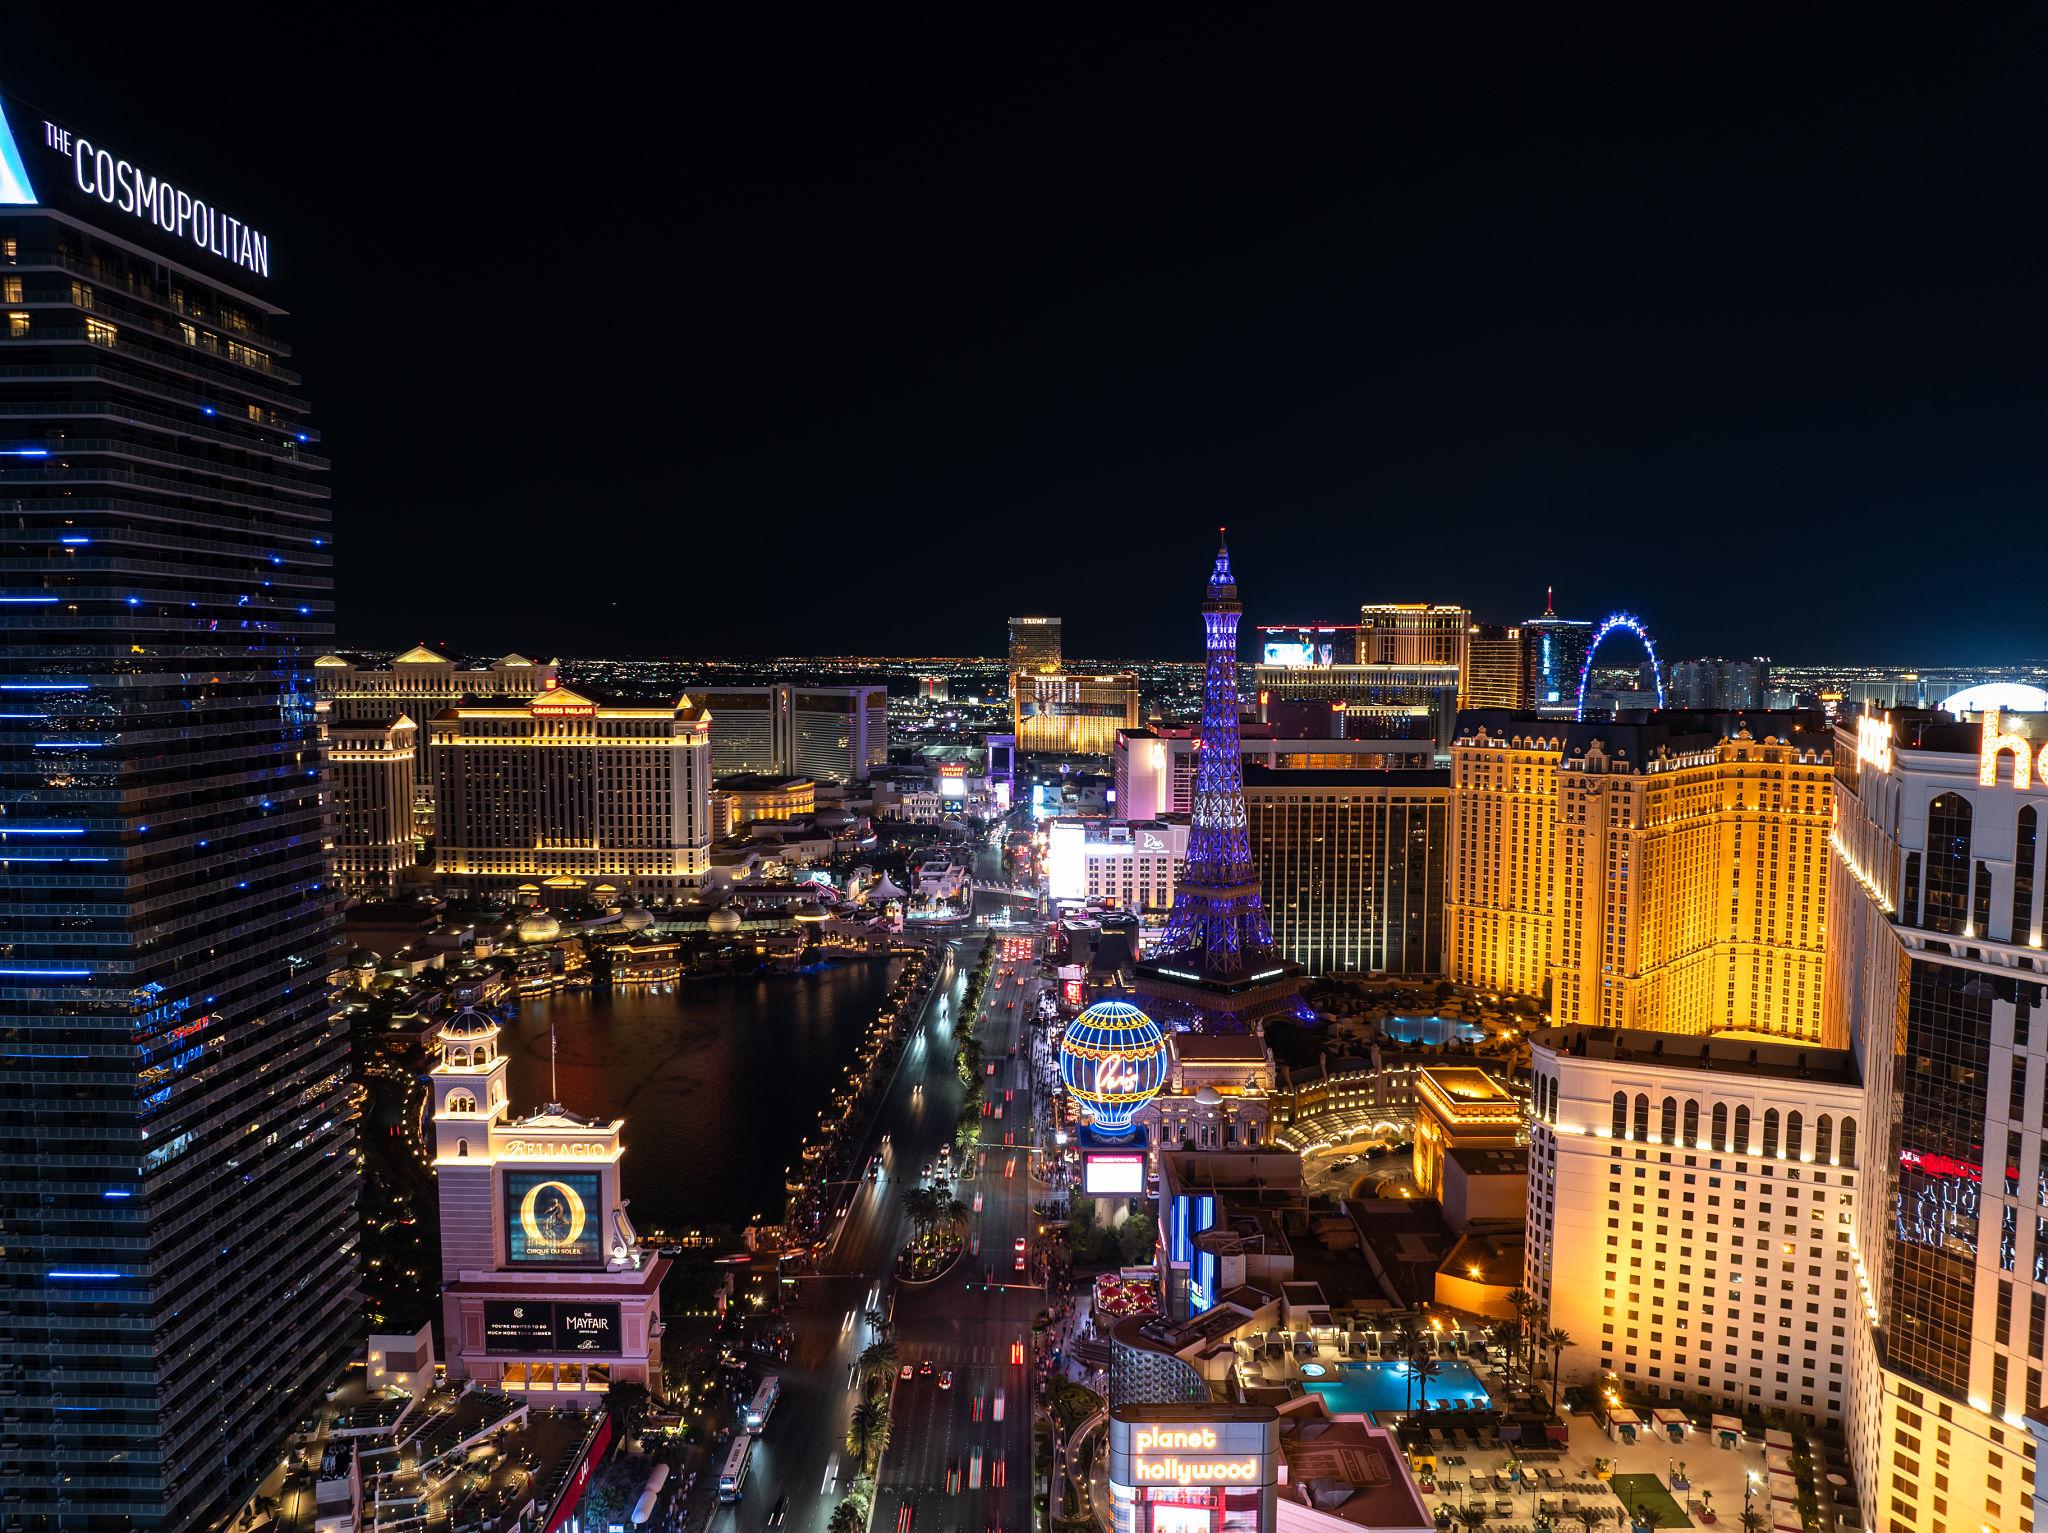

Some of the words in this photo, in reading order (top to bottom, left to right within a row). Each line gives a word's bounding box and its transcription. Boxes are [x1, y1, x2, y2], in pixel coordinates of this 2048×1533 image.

[44, 121, 72, 157] THE
[76, 139, 269, 278] COSMOPOLITAN
[1979, 709, 2048, 790] h
[1095, 1054, 1138, 1102] Paris
[506, 1140, 605, 1157] BELLAGIO
[520, 1181, 586, 1246] O
[526, 1248, 550, 1256] CIRQUE
[566, 1316, 609, 1330] MAYFAIR
[1136, 1426, 1216, 1453] planet
[1136, 1458, 1257, 1485] hollywood
